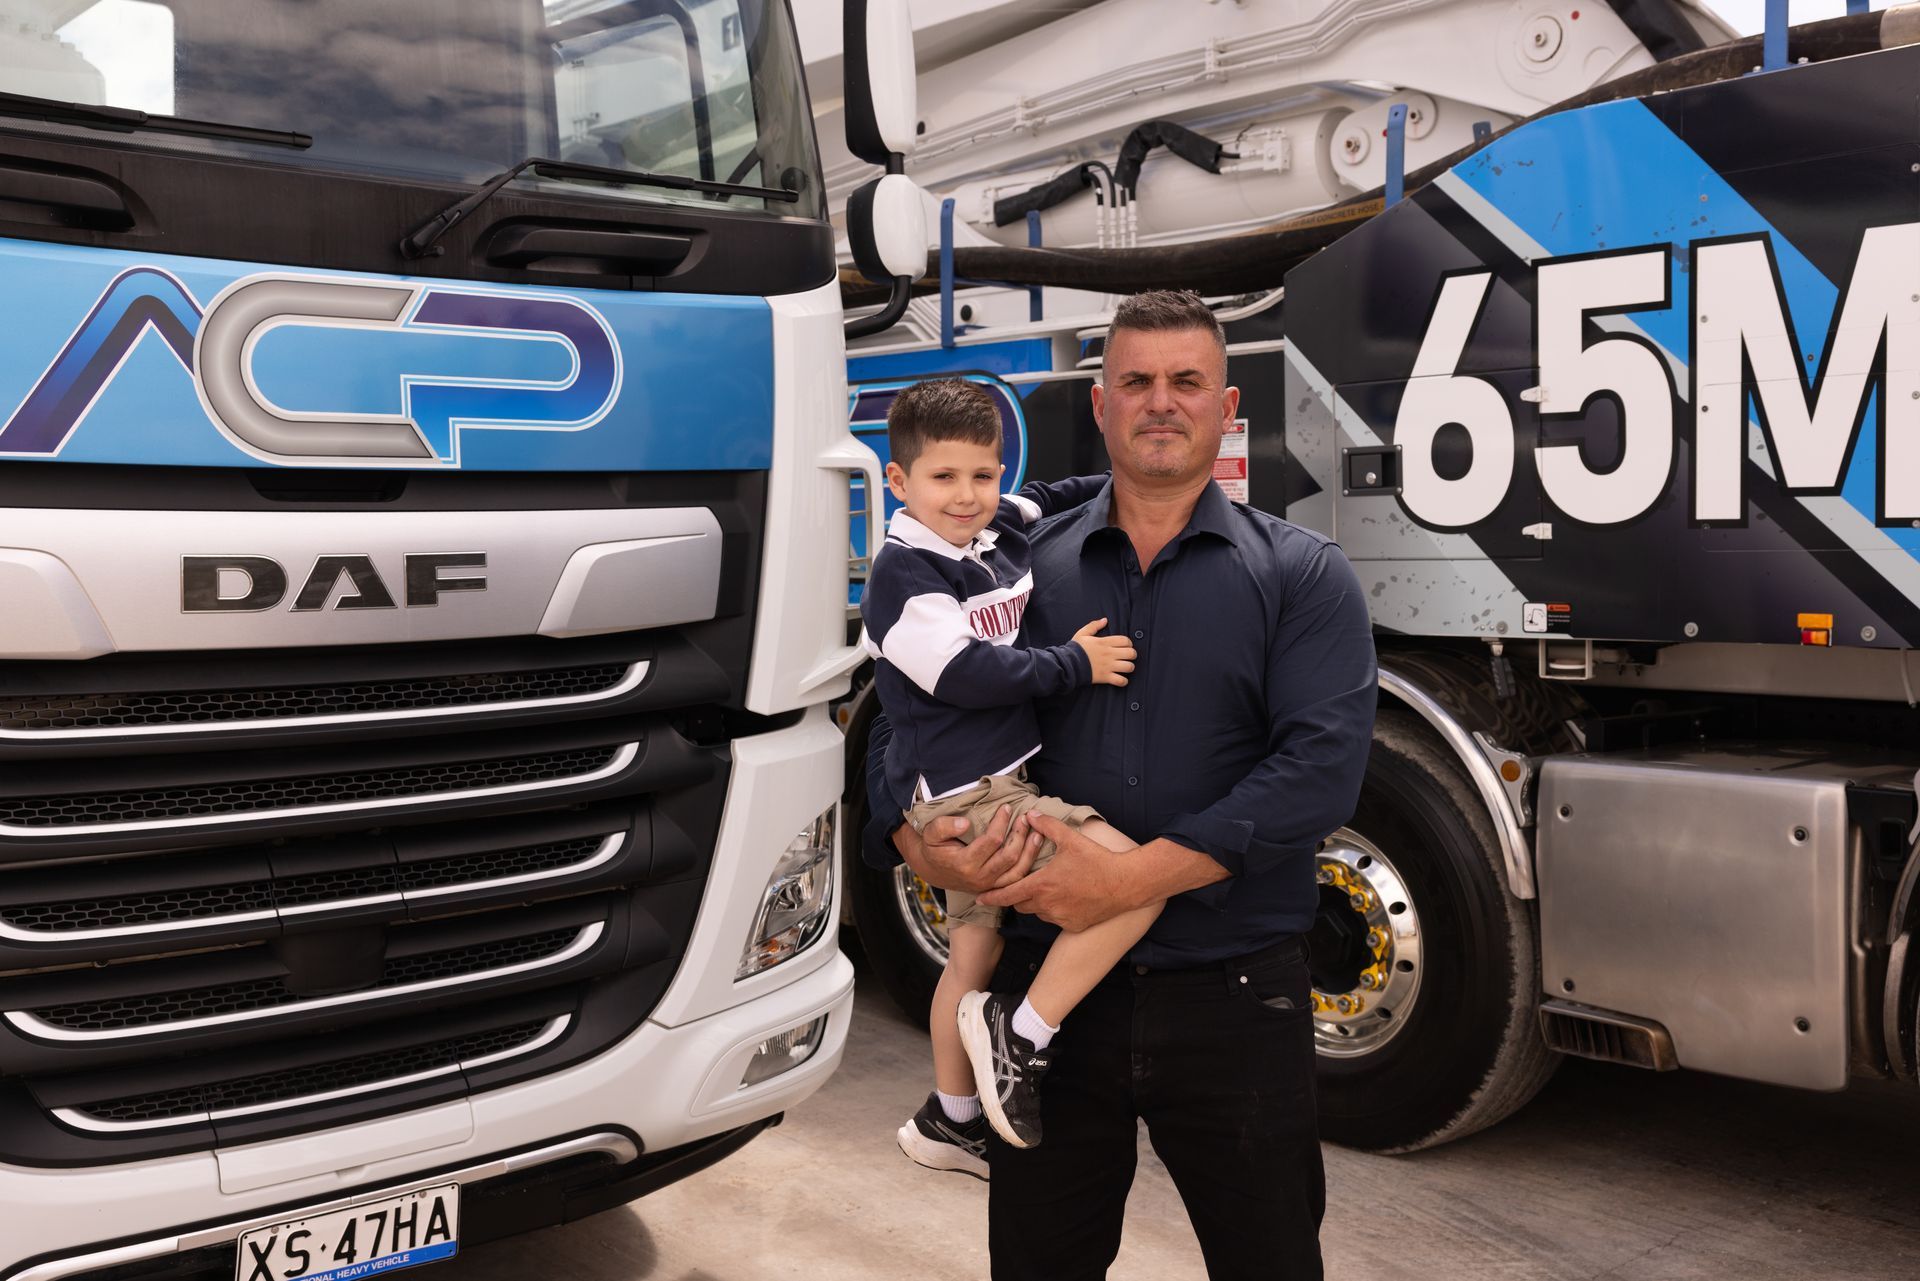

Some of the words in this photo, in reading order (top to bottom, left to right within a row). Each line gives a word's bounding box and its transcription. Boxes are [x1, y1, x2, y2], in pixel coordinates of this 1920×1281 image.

[0, 265, 623, 468] ACP
[1391, 220, 1920, 533] 65M
[180, 550, 488, 614] DAF
[336, 1263, 370, 1279] HEAVY
[371, 1253, 411, 1271] VEHICLE
